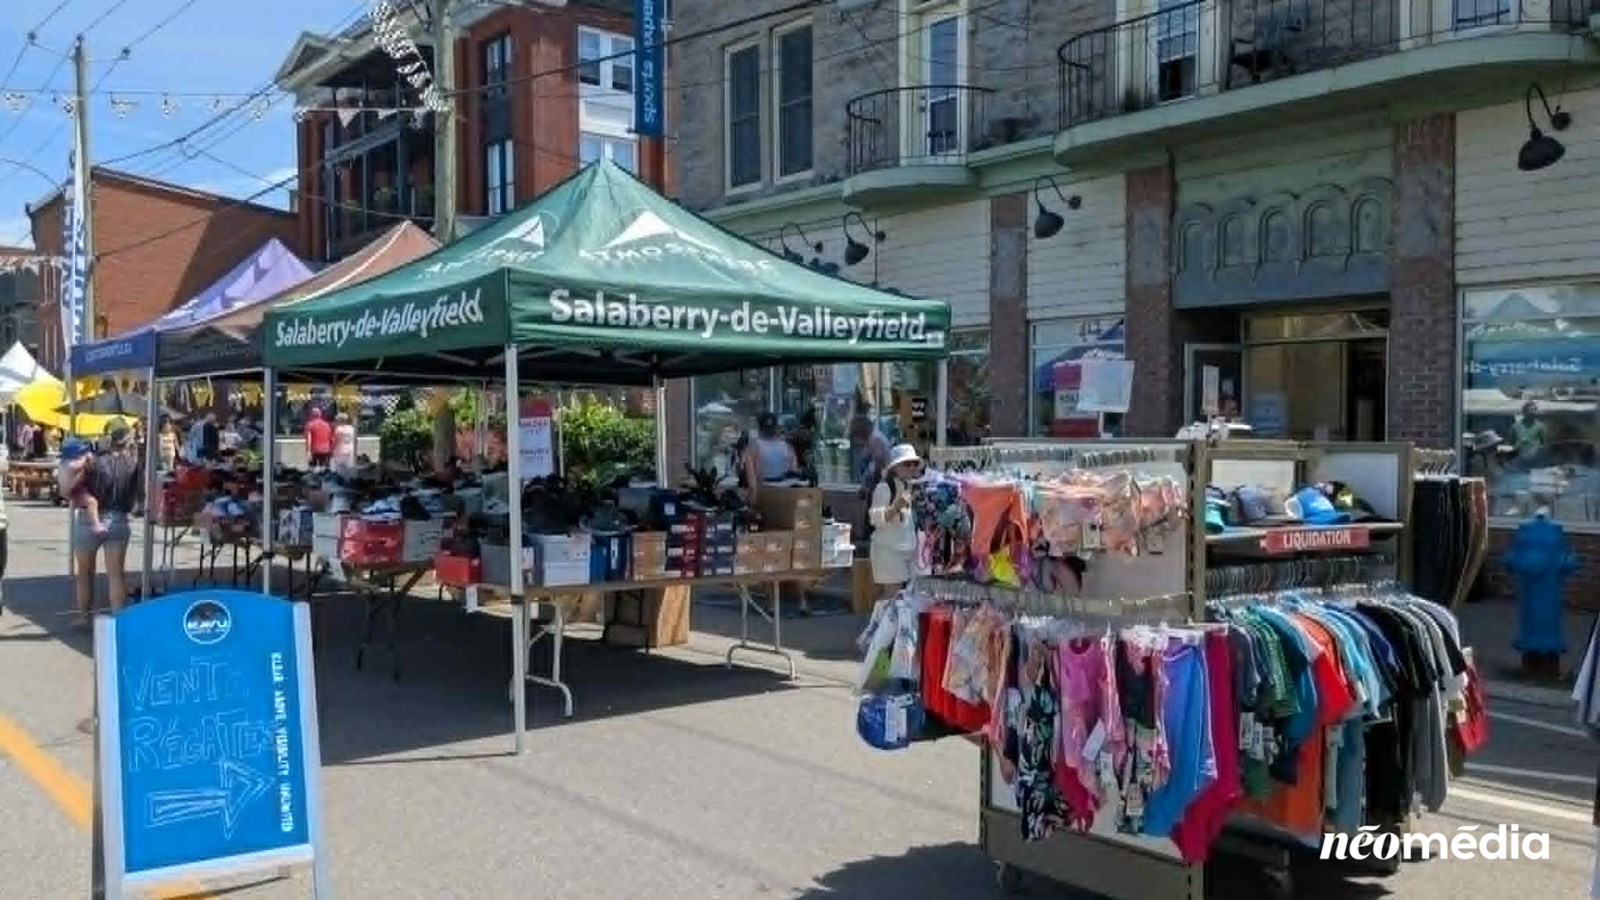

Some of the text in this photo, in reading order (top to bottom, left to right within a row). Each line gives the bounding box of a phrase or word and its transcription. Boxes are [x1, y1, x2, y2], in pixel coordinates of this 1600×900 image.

[275, 287, 484, 348] Salaberry-de-Valleyfield
[549, 288, 926, 343] Salaberry-de-Valleyfield
[1283, 530, 1351, 550] LIQUIDATION
